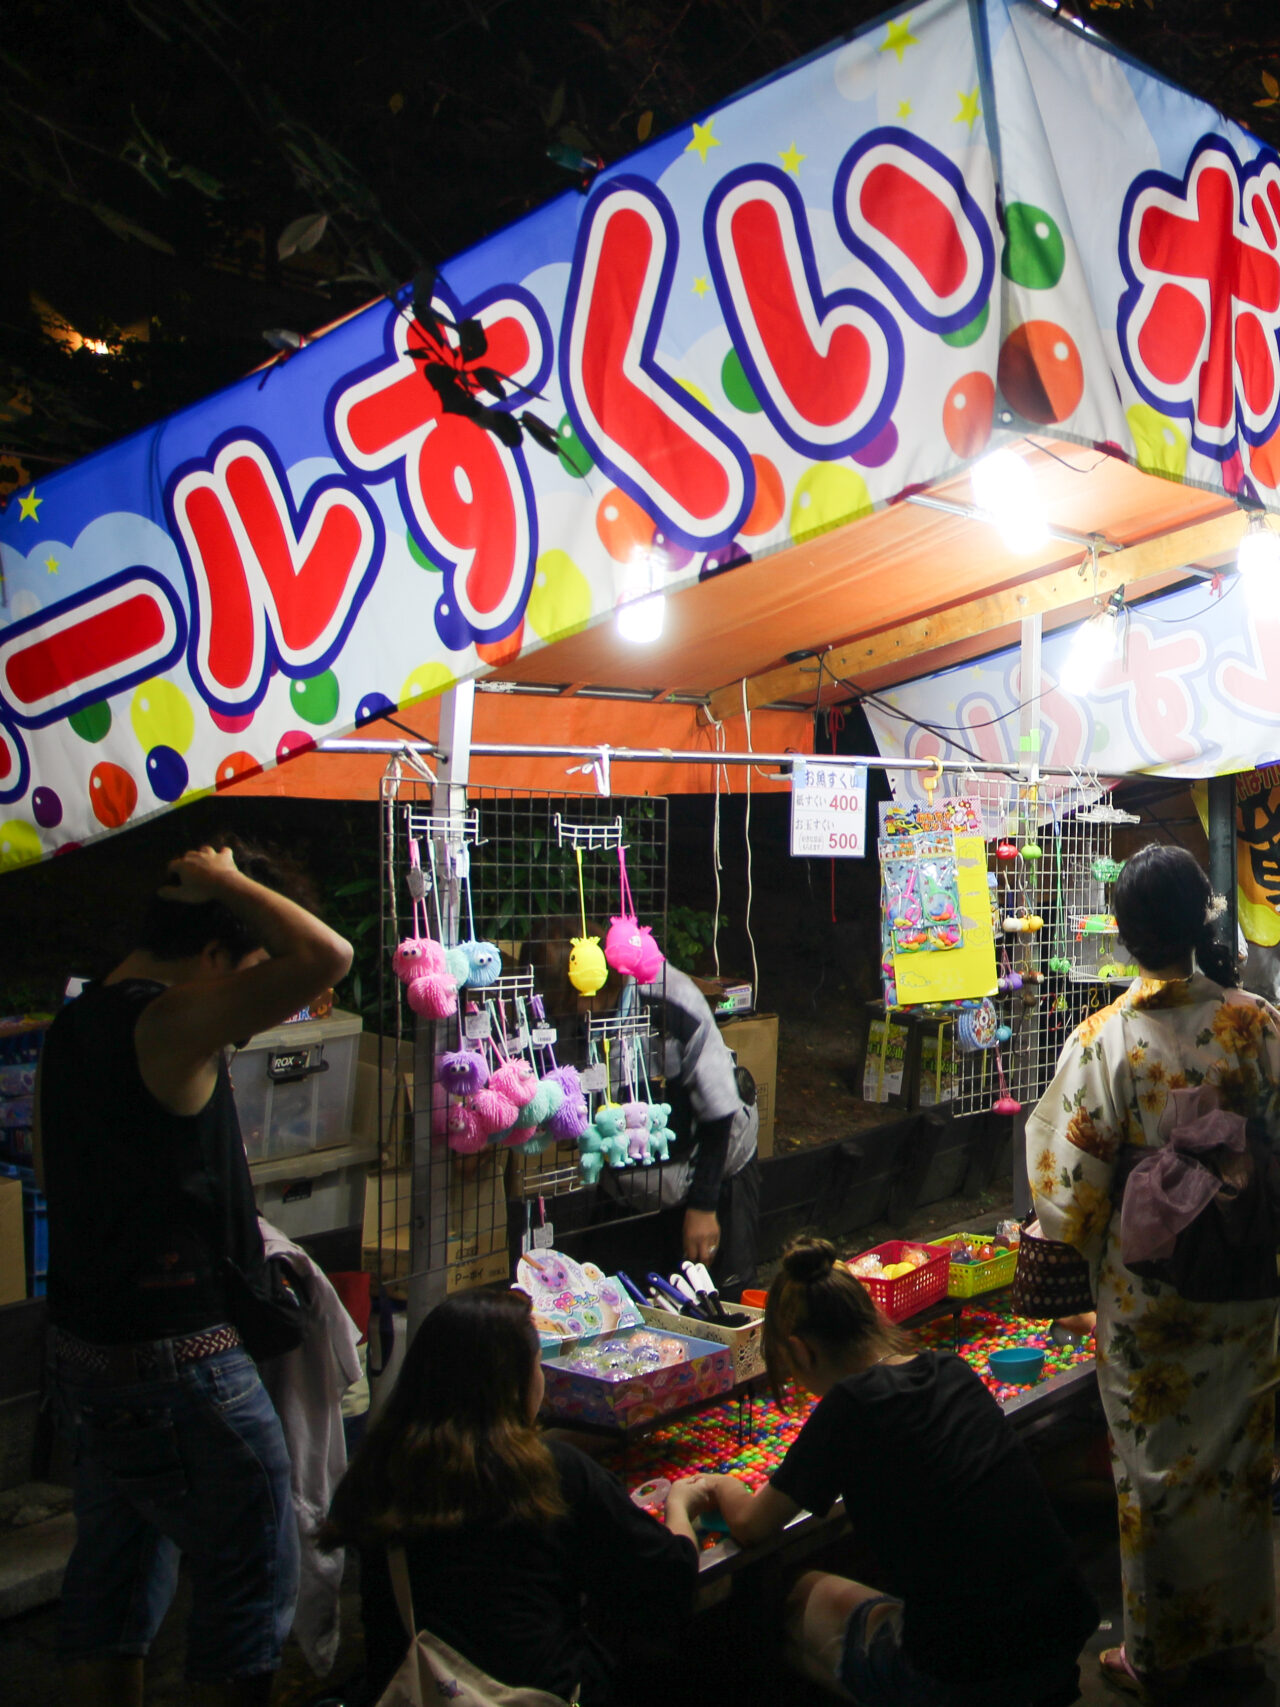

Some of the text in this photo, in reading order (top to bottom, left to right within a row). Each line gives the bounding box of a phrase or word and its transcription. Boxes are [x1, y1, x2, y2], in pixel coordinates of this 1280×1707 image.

[0, 125, 995, 798] ールすくい
[829, 794, 859, 811] 400
[829, 833, 859, 849] 500
